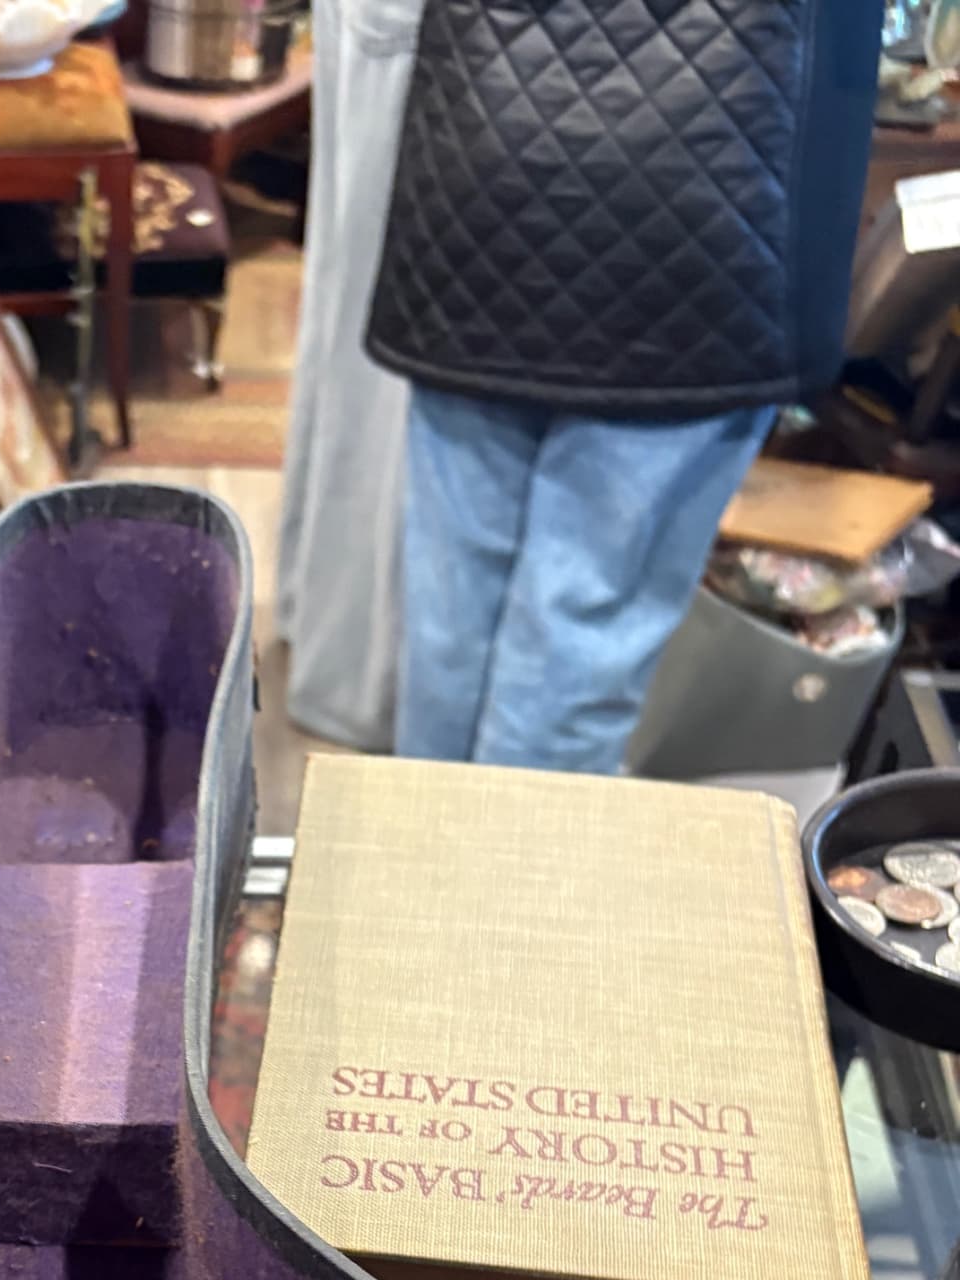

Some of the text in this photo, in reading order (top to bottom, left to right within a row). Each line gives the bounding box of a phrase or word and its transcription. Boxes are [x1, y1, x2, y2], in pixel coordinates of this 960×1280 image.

[331, 1067, 758, 1137] UNITED STATES
[324, 1109, 758, 1182] HISTORY OF THE
[320, 1154, 769, 1232] The Beards' BASIC
